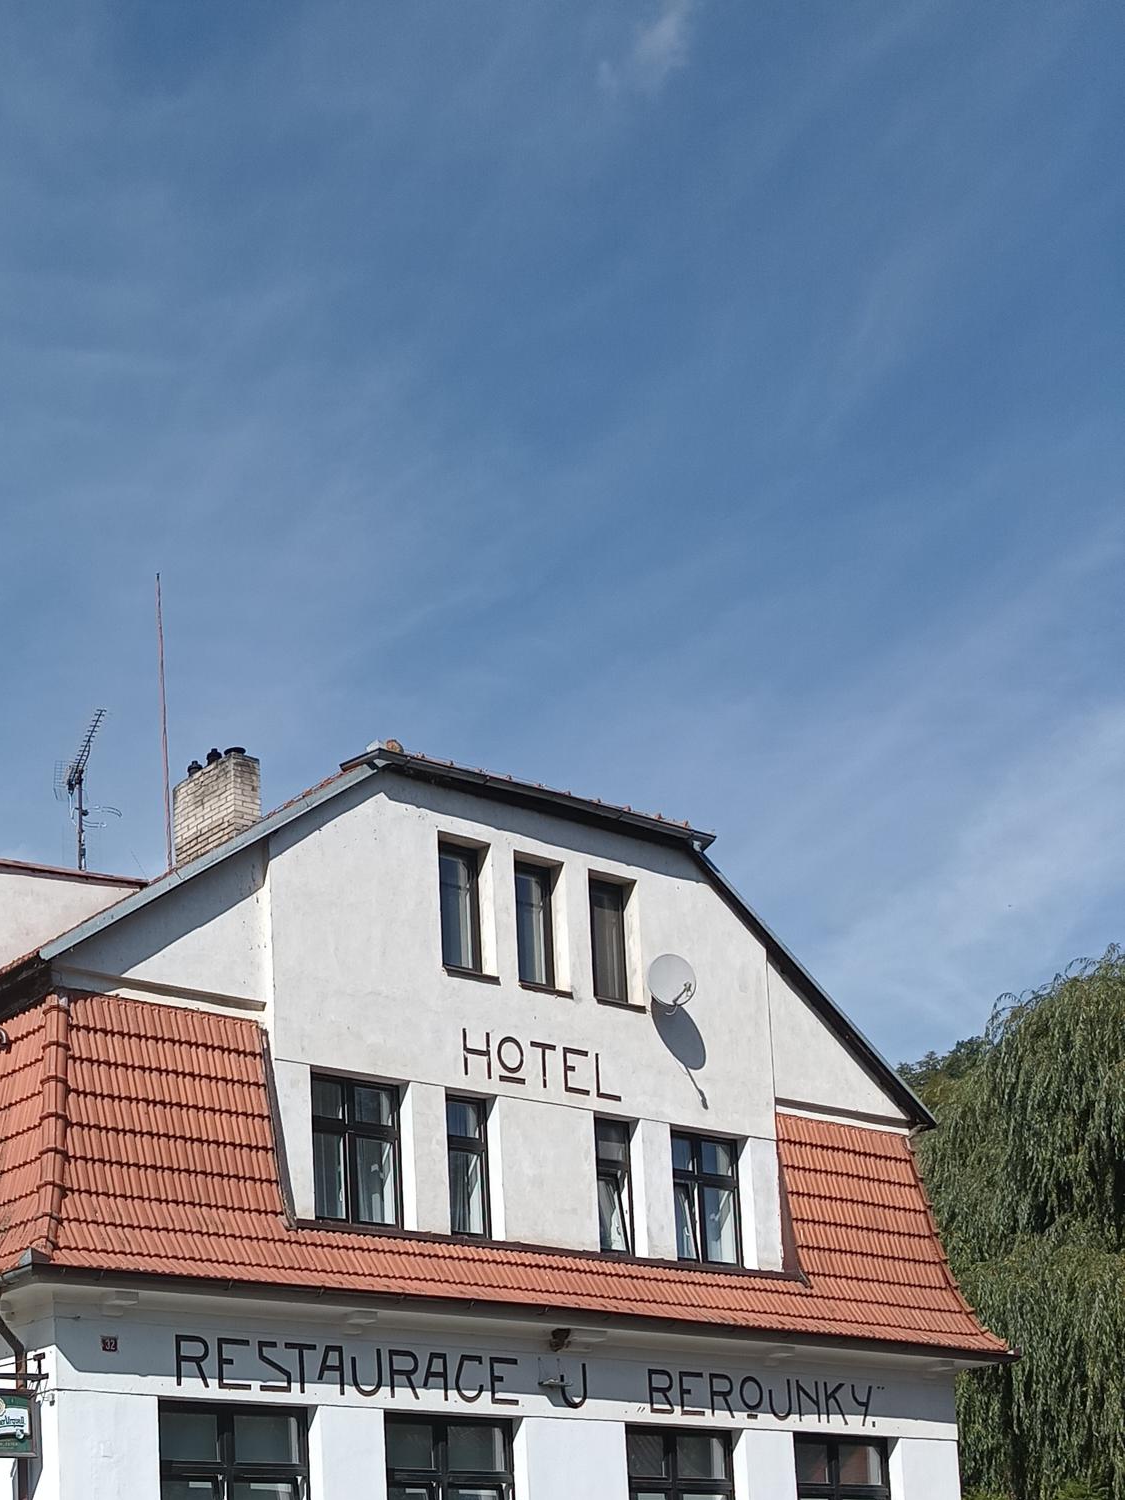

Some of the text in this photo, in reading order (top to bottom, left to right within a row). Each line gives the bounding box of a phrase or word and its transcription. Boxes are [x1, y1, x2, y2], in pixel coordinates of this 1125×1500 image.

[462, 1027, 622, 1102] HOTEL
[105, 1339, 116, 1350] 32
[174, 1334, 520, 1406] RESTAURACE
[560, 1362, 588, 1409] U
